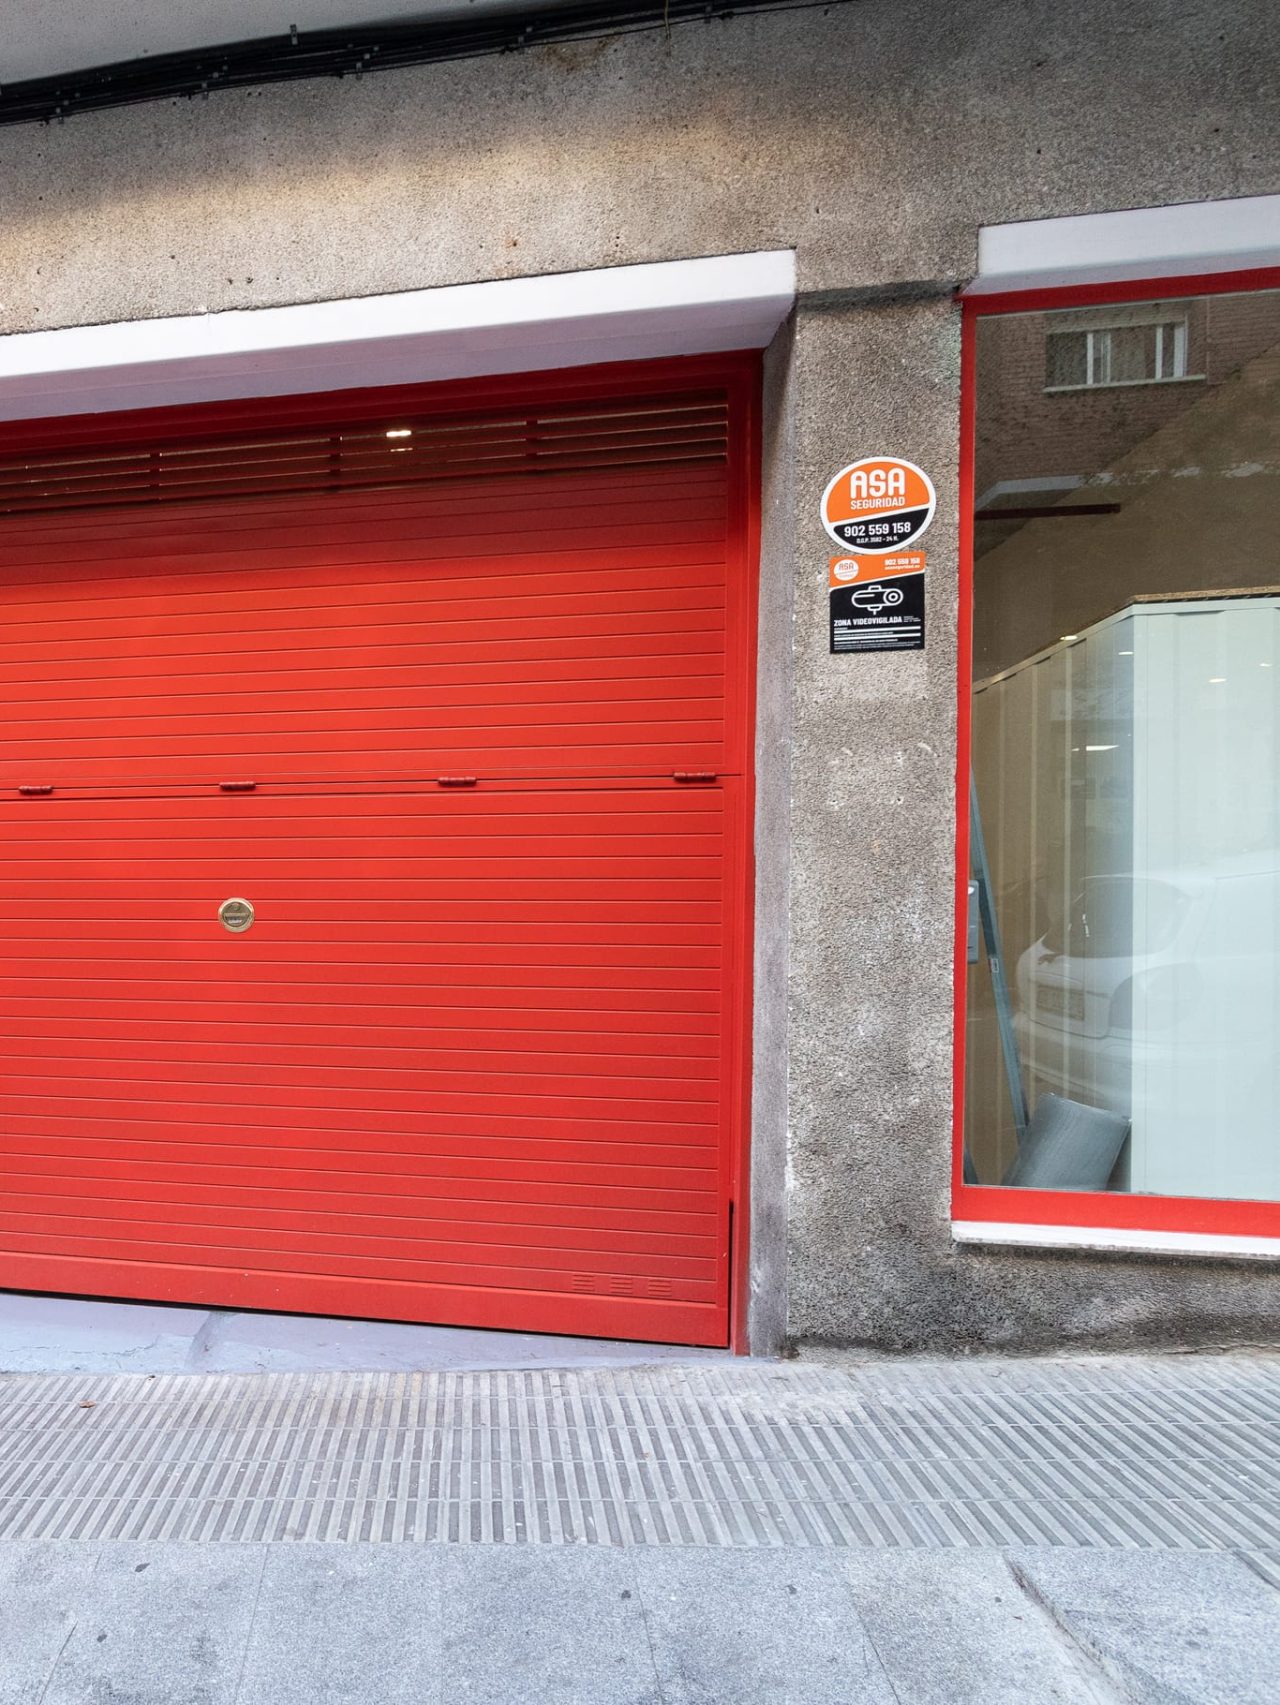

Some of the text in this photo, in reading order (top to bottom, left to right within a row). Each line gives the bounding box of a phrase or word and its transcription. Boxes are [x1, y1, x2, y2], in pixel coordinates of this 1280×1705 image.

[850, 467, 906, 499] ASA
[850, 496, 906, 510] SEGURIDAD
[844, 521, 911, 537] 902 559 158
[838, 562, 854, 571] ASA
[833, 619, 851, 627] ZONA
[852, 615, 903, 626] VIDEOVIGILADA
